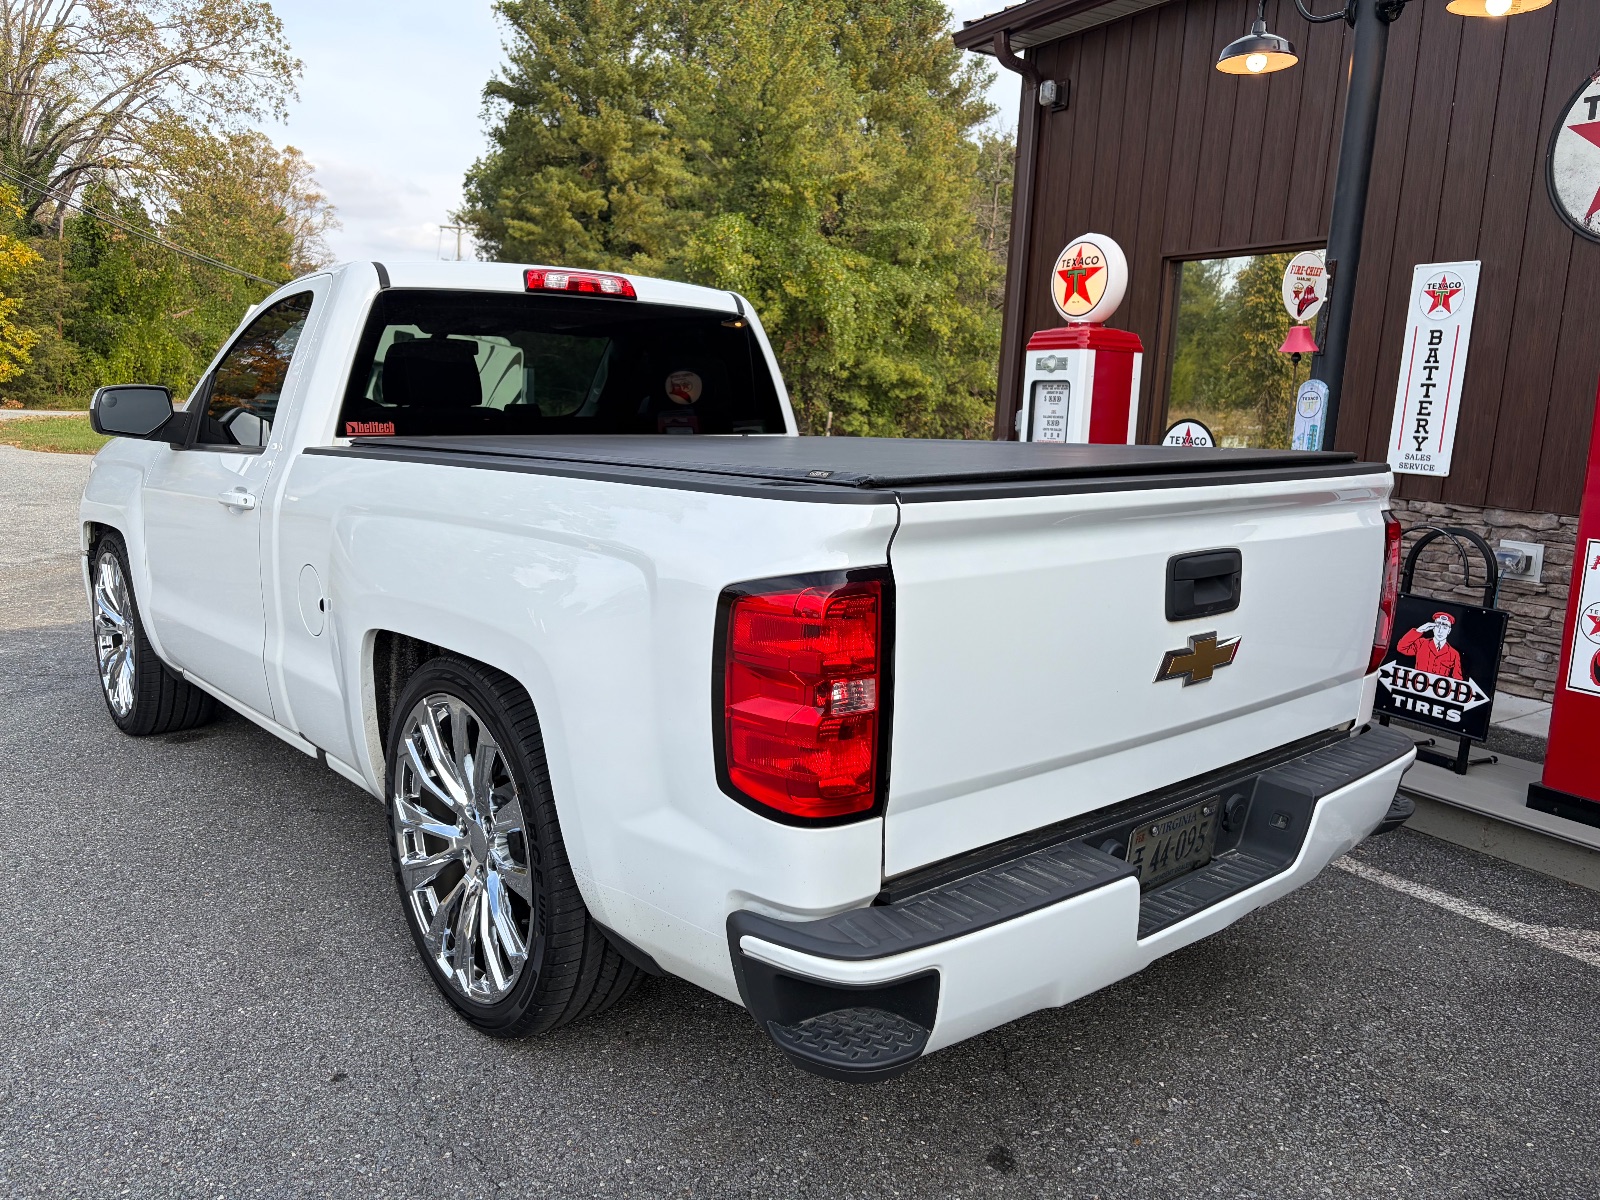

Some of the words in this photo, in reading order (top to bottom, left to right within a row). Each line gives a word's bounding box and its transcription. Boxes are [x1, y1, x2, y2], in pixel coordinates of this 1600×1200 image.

[1061, 255, 1100, 269] TEXACO
[1289, 264, 1324, 277] FIRE-CHIEF
[1426, 281, 1462, 290] TEXACO
[1412, 329, 1444, 452] BATTERY
[358, 421, 395, 433] belltech
[1169, 435, 1207, 447] TEXACO
[1404, 452, 1432, 462] SALES
[1398, 461, 1436, 472] SERVICE
[1388, 666, 1473, 704] HOOD
[1391, 693, 1462, 723] TIRES
[1157, 812, 1197, 835] VIRGINIA
[516, 782, 544, 888] FORCE
[1149, 821, 1209, 873] 44-095
